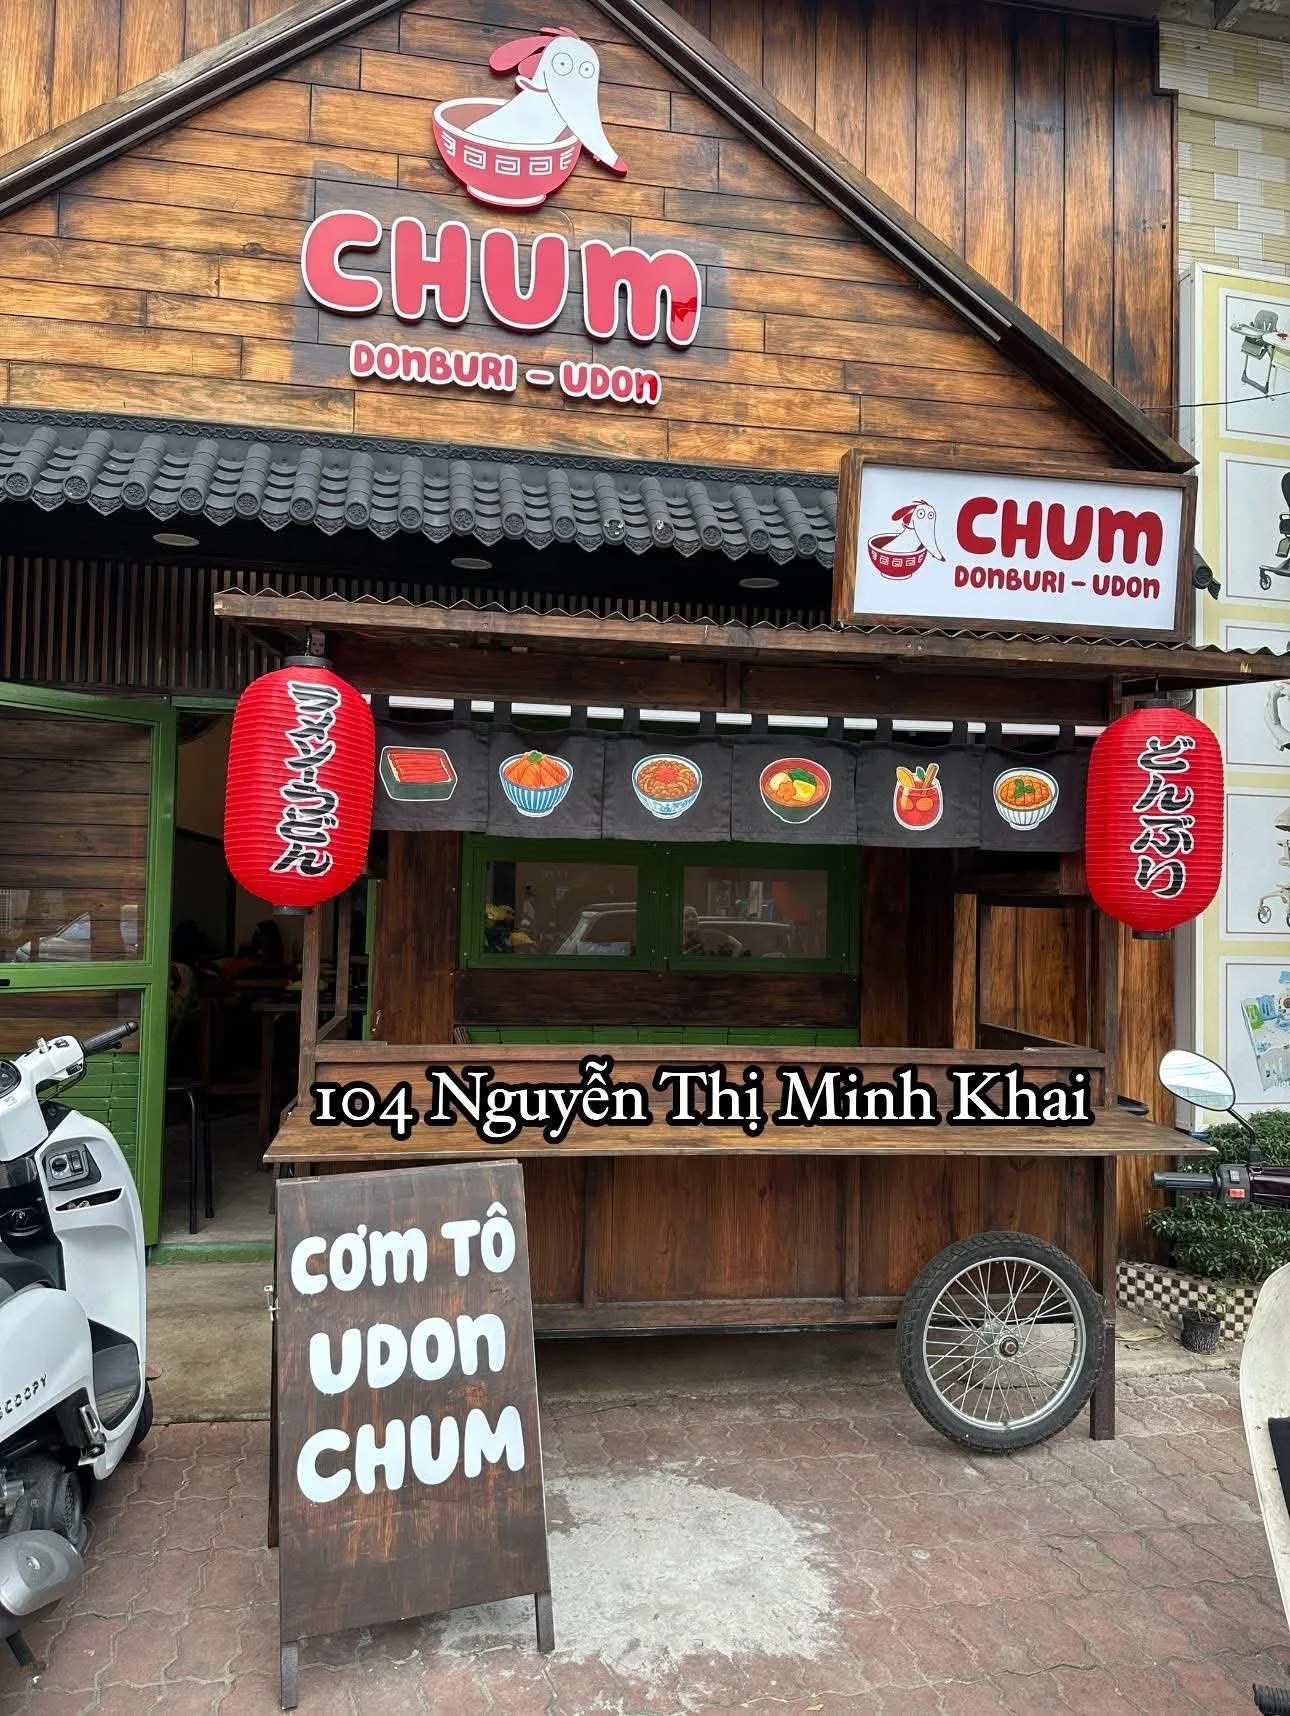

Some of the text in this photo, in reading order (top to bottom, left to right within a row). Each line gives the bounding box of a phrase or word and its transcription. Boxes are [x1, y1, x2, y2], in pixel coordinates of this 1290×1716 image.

[1130, 736, 1195, 898] どんぶり
[441, 1201, 516, 1277] TÔ
[297, 1405, 525, 1503] CHUM
